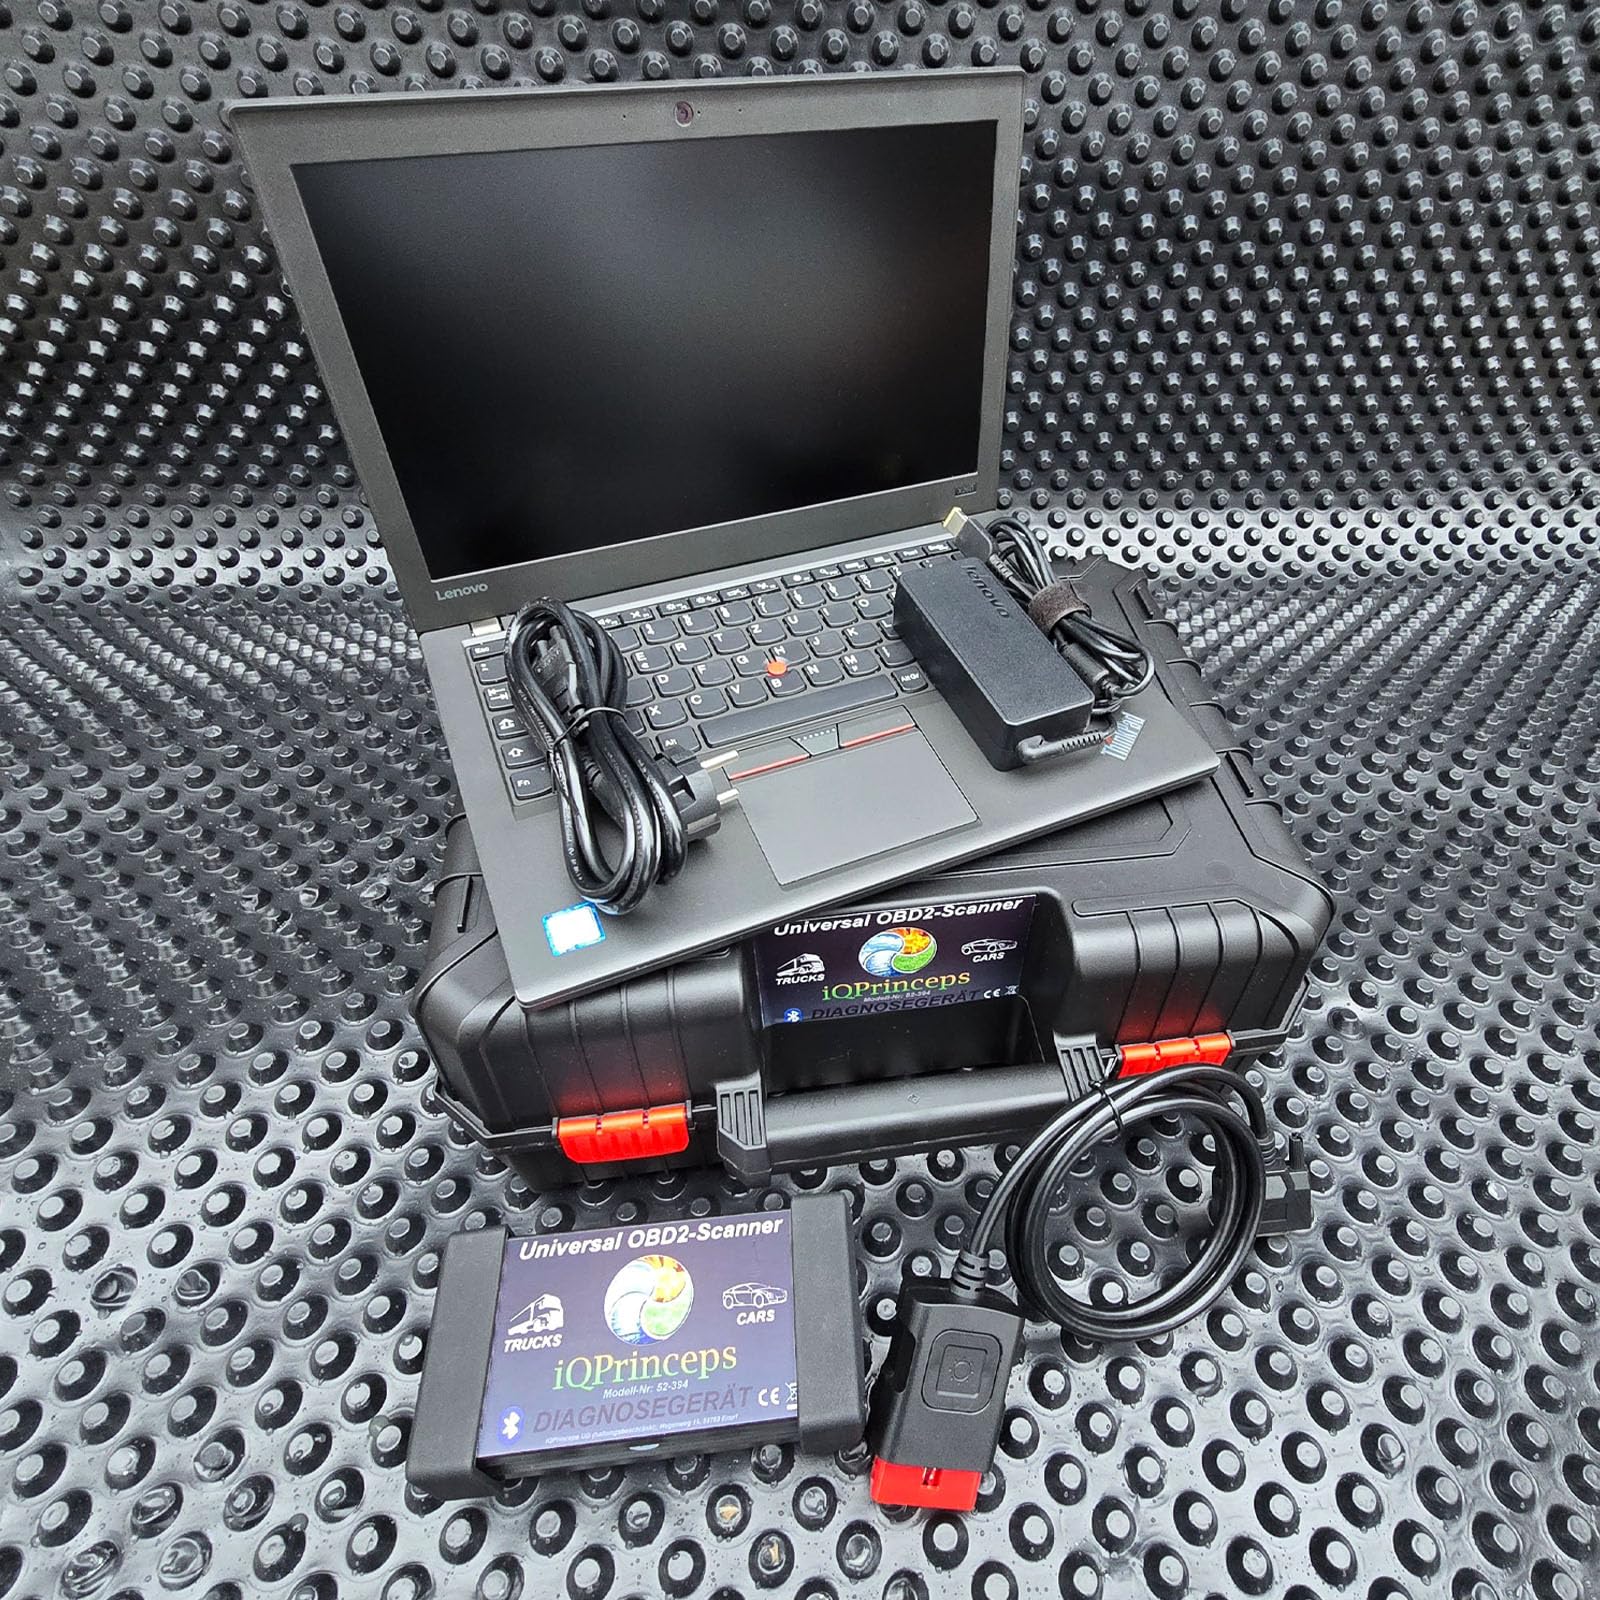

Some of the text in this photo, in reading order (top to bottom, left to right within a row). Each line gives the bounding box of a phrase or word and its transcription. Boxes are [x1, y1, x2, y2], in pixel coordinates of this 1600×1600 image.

[435, 583, 488, 601] Lenovo
[1101, 711, 1146, 761] ThinkPad
[774, 899, 1024, 937] Universal OBD2-Scanner
[972, 952, 1005, 963] CARS
[776, 973, 825, 985] TRUCKS
[822, 972, 970, 1002] iQPrinceps
[811, 989, 981, 1020] DIAGNOSEGERÄT
[519, 1218, 784, 1261] Universal OBD2-Scanner
[736, 1309, 776, 1326] CARS
[503, 1333, 563, 1352] TRUCKS
[552, 1346, 738, 1391] iQPrinceps
[603, 1384, 654, 1400] Modell-Nr:
[533, 1384, 752, 1434] DIAGNOSEGERÄT
